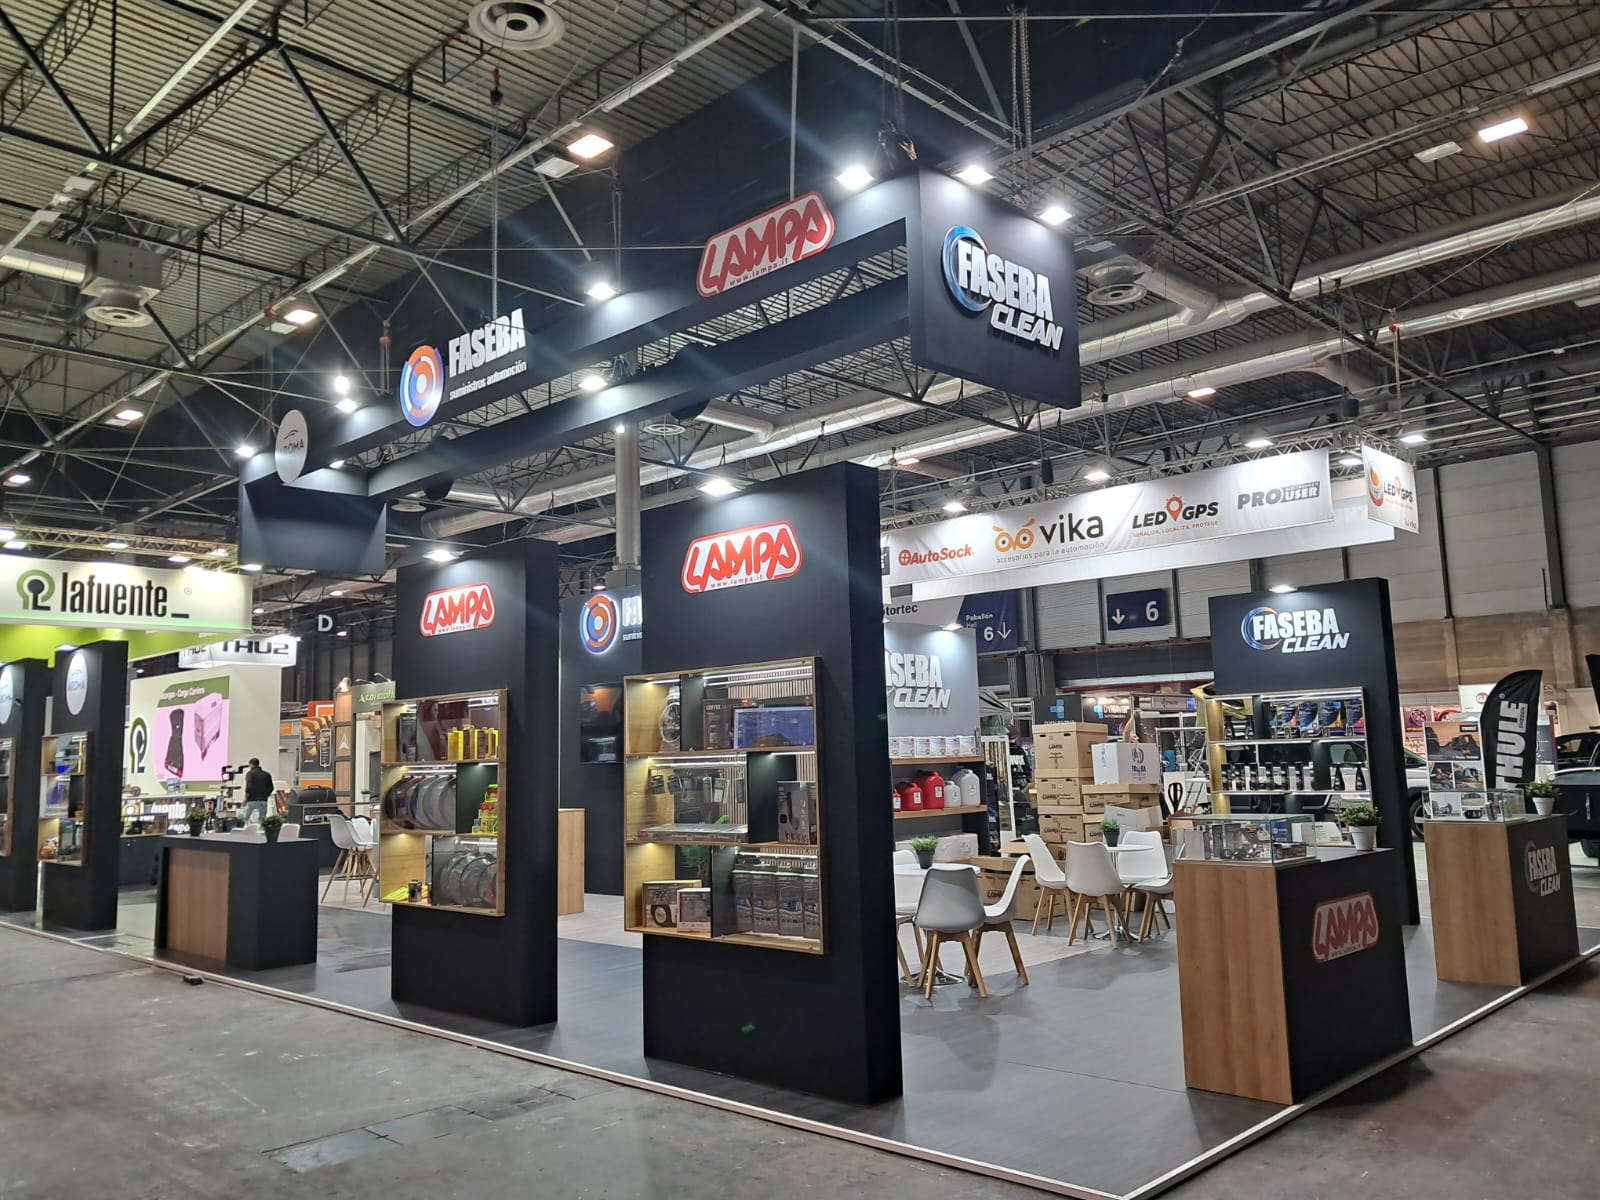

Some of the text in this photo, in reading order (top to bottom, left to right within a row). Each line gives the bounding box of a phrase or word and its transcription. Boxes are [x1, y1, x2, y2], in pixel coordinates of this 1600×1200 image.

[703, 198, 827, 292] LAMPA
[729, 258, 789, 286] www.lampa.it
[958, 239, 1053, 321] FASEBA
[449, 308, 526, 378] FASEBA
[991, 304, 1063, 350] CLEAN
[1039, 512, 1104, 545] vika
[1132, 502, 1219, 529] LED GPS
[687, 527, 797, 591] LAMPA
[911, 543, 972, 566] AutoSock
[317, 614, 333, 632] D
[423, 587, 493, 634] LAMPA
[1145, 600, 1159, 622] 6
[1252, 608, 1339, 641] FASEBA
[983, 626, 994, 642] 6
[1282, 632, 1350, 653] CLEAN
[893, 687, 951, 708] CLEAN
[1528, 846, 1558, 882] FASEBA
[1540, 872, 1561, 897] CLEAN
[1315, 897, 1378, 960] LAMPA
